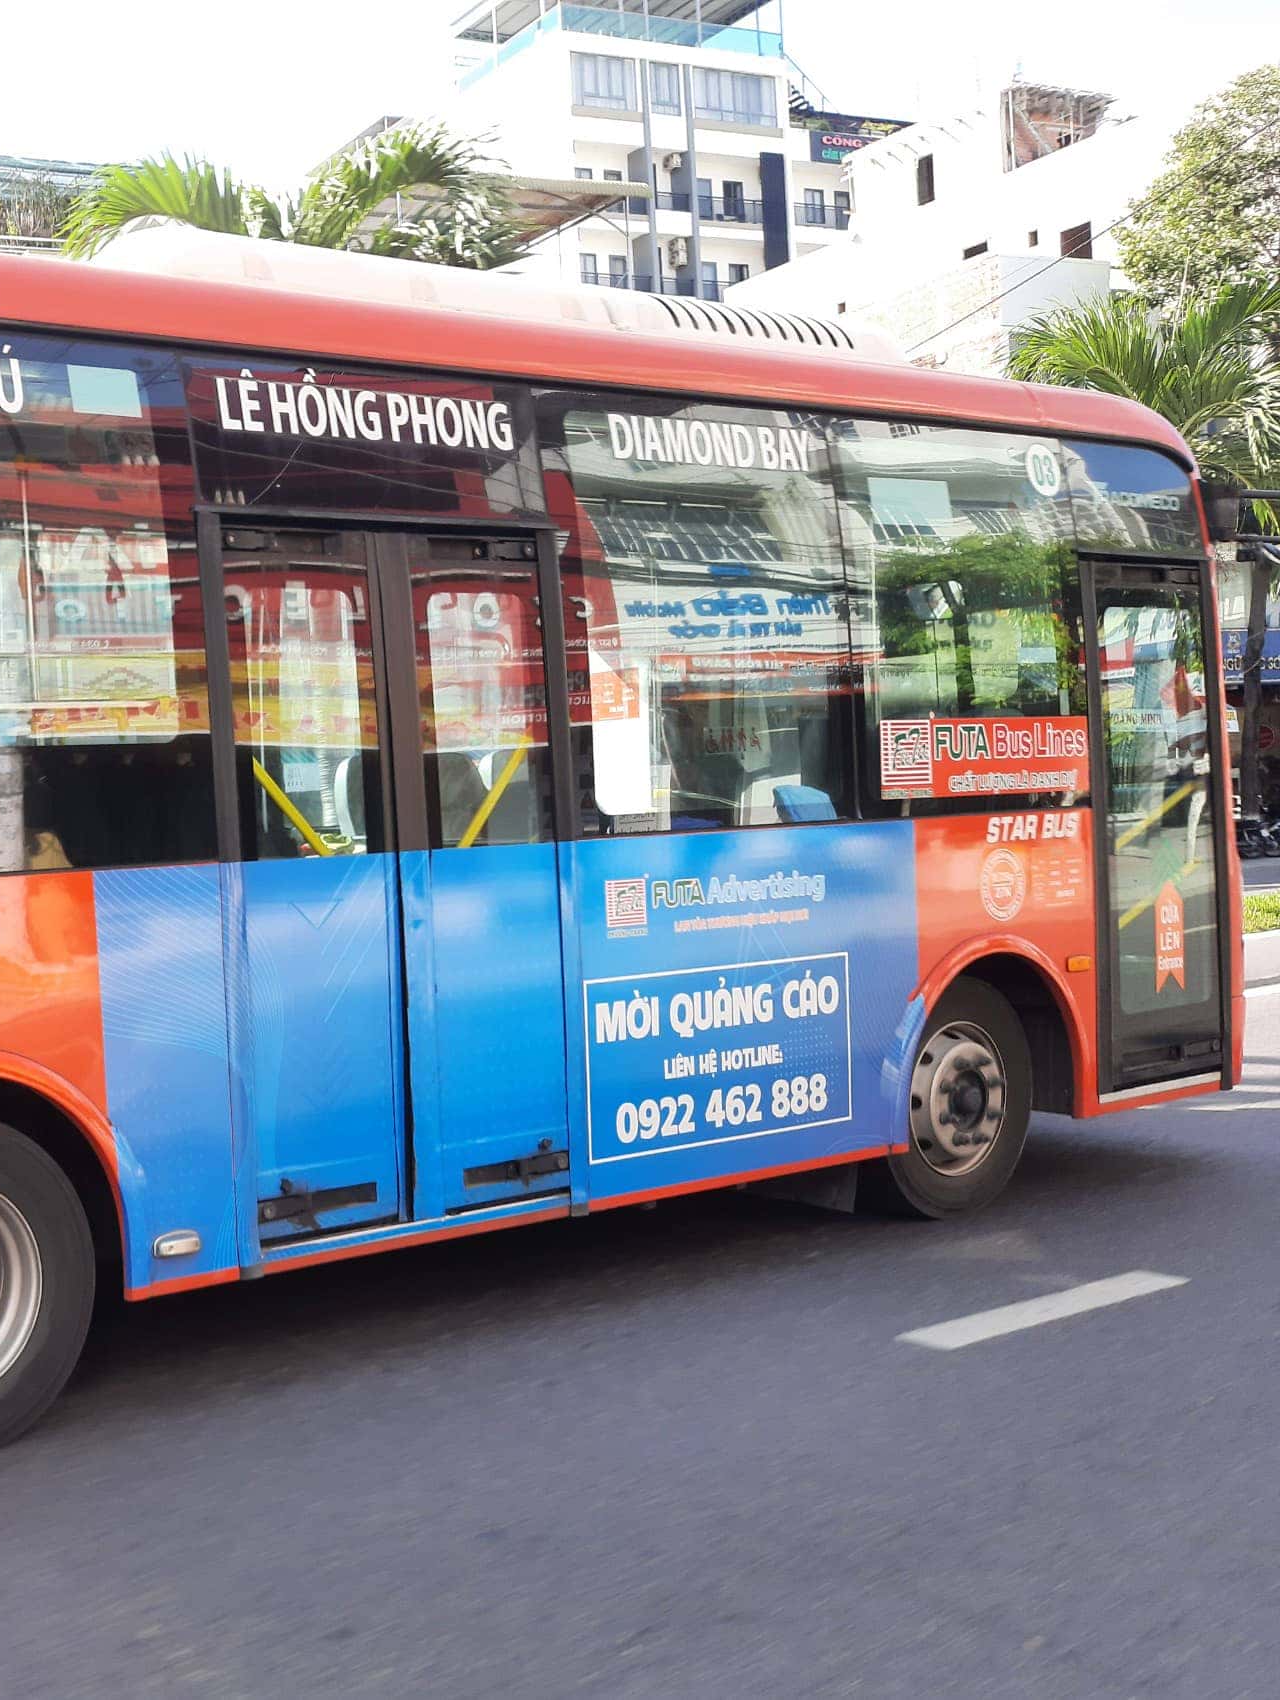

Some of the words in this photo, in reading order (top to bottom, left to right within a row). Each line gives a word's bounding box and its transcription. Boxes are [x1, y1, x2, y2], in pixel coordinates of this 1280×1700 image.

[215, 370, 264, 434] LÊ
[272, 366, 382, 442] HỒNG
[390, 393, 514, 452] PHONG
[608, 413, 753, 470] DIAMOND
[758, 426, 812, 472] BAY
[1032, 454, 1056, 487] 03
[933, 724, 991, 762] FUTA
[993, 725, 1033, 760] Bus
[1033, 722, 1087, 758] Lines
[986, 814, 1039, 844] STAR
[1041, 811, 1081, 840] BUS
[651, 878, 705, 910] FUTA
[705, 870, 826, 903] Advertising
[595, 990, 660, 1043] MỜI
[669, 977, 773, 1038] QUẢNG
[782, 970, 840, 1019] CÁO
[663, 1055, 696, 1080] LIÊN
[699, 1048, 718, 1079] HỆ
[616, 1094, 696, 1144] 0922
[704, 1083, 763, 1128] 462
[771, 1073, 828, 1119] 888
